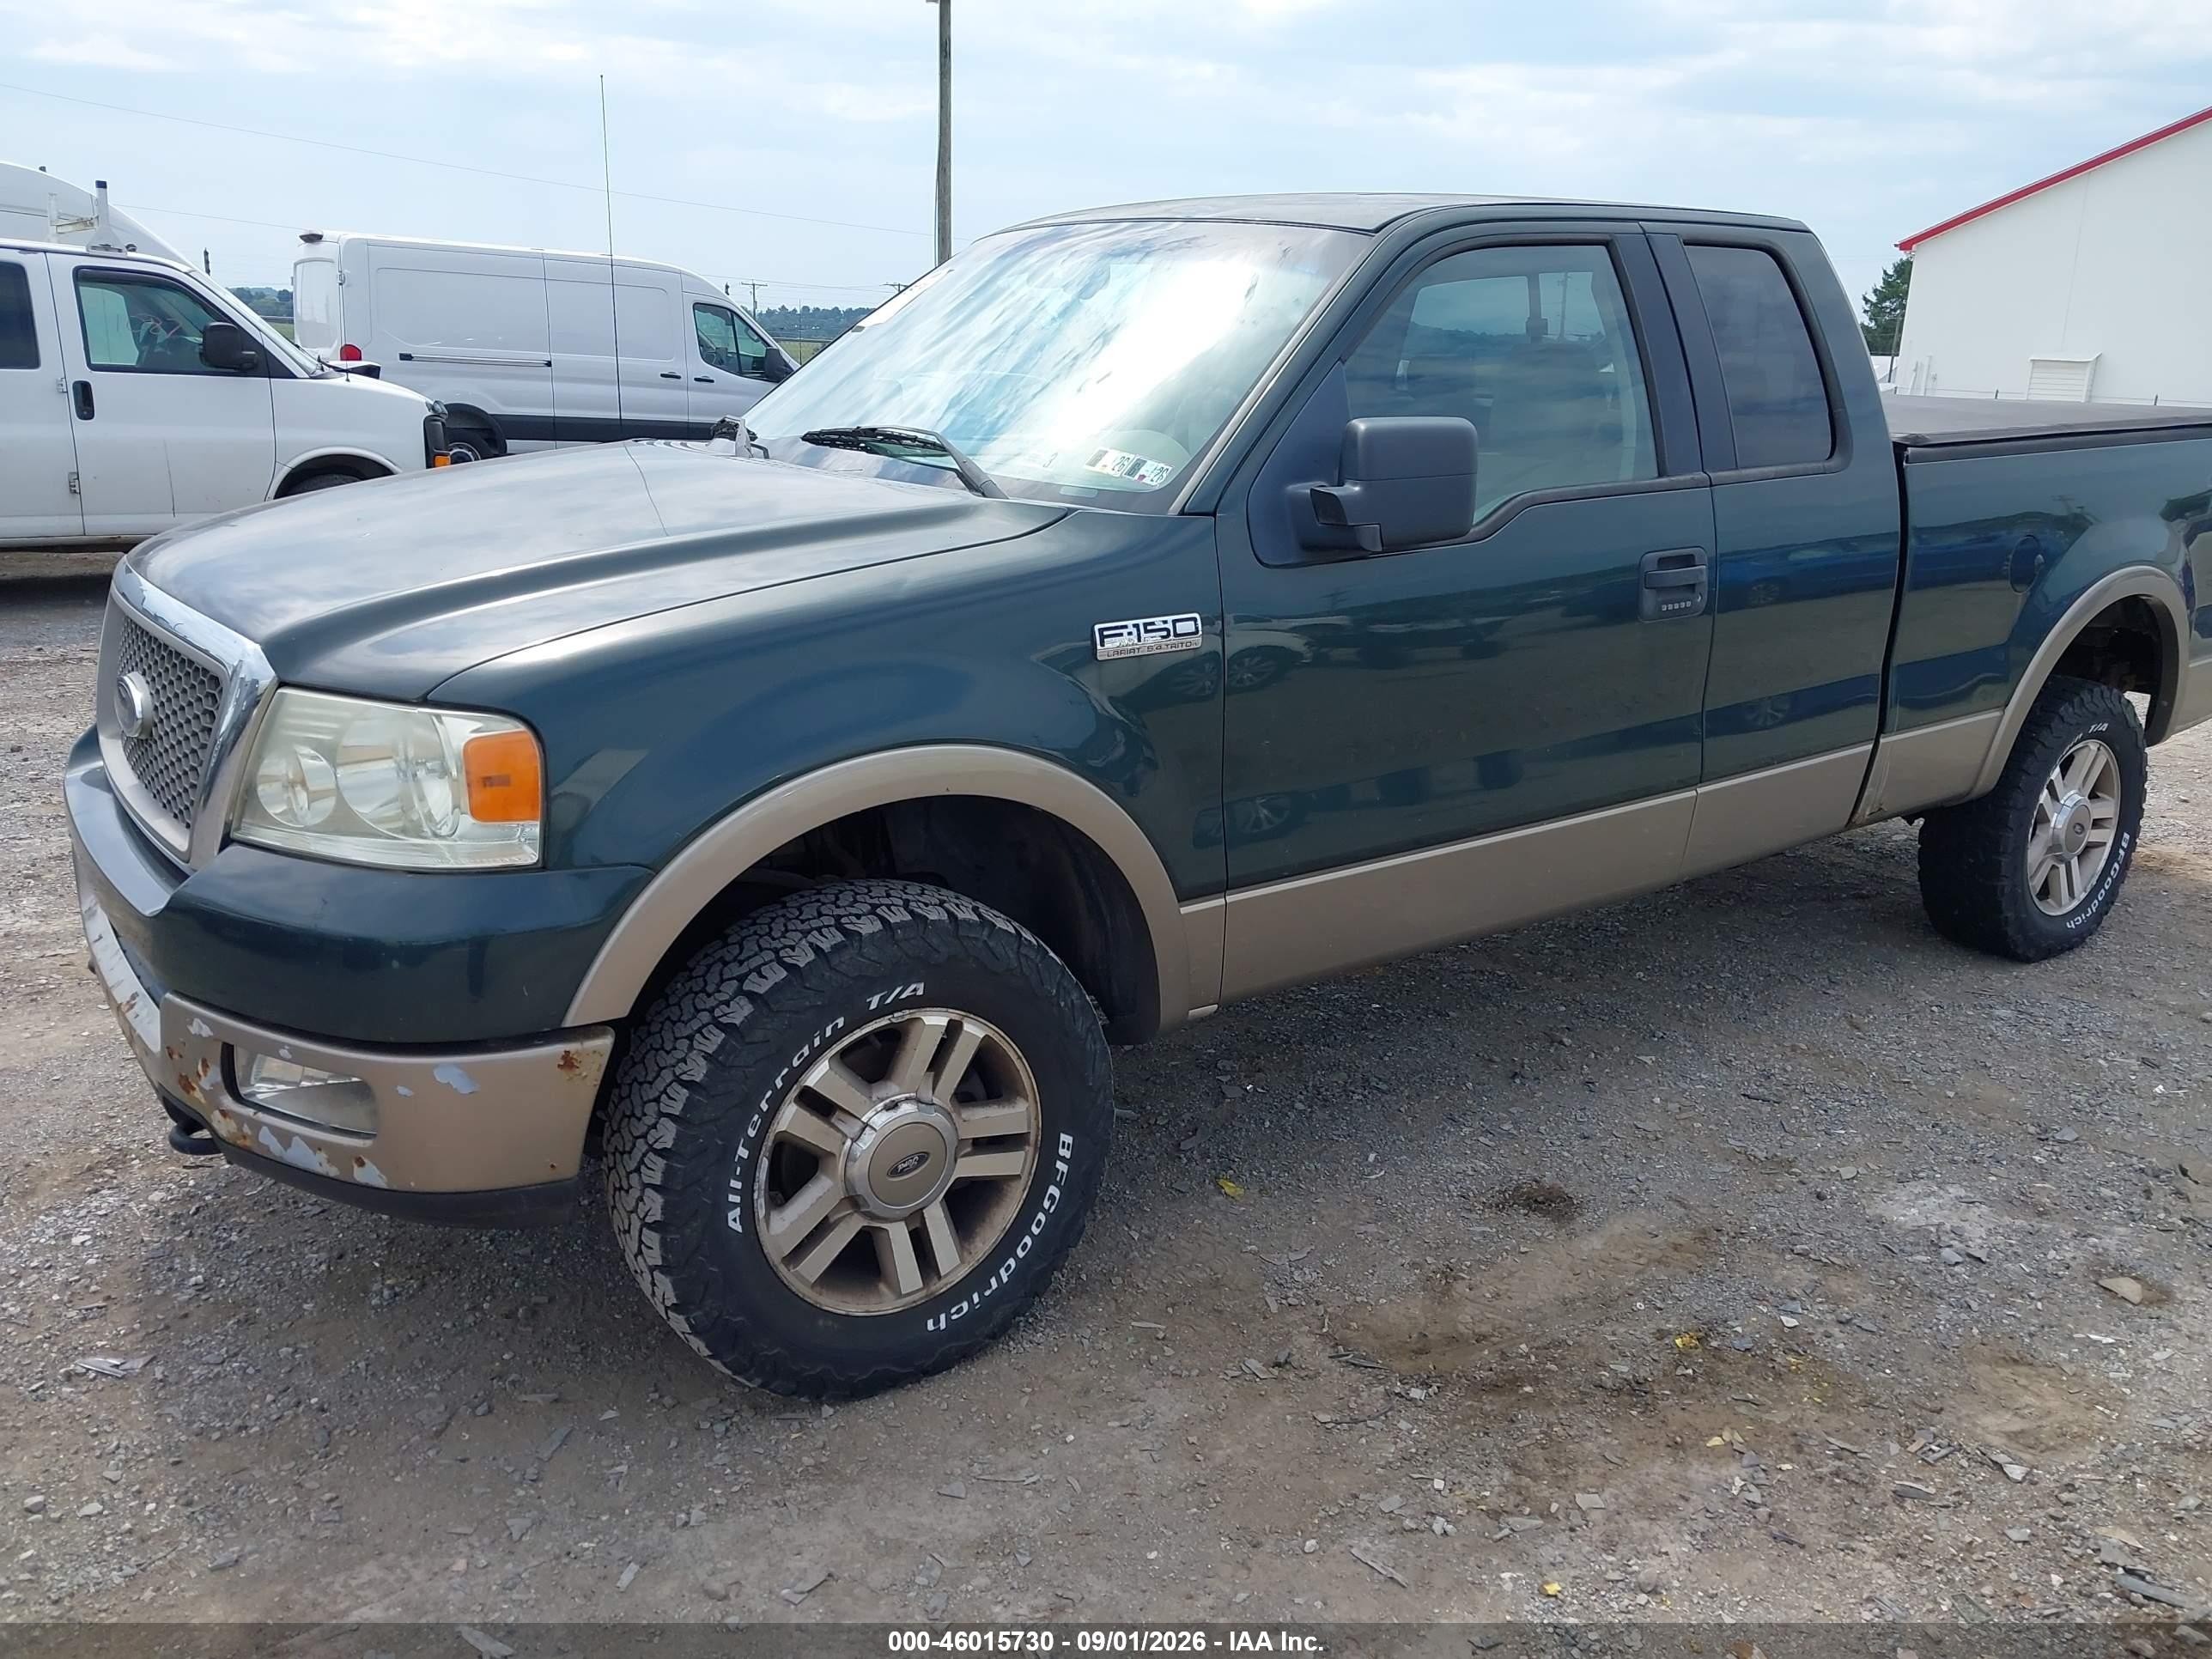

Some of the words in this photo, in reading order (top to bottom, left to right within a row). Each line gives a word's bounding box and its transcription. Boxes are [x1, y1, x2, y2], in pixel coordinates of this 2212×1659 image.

[1097, 617, 1200, 647] F-150
[1106, 646, 1142, 658] LARIAT
[2065, 831, 2130, 929] BFGoodrich
[726, 1015, 846, 1234] All-Terrain
[866, 981, 926, 1011] T/A
[926, 1132, 1074, 1334] BFGoodrich
